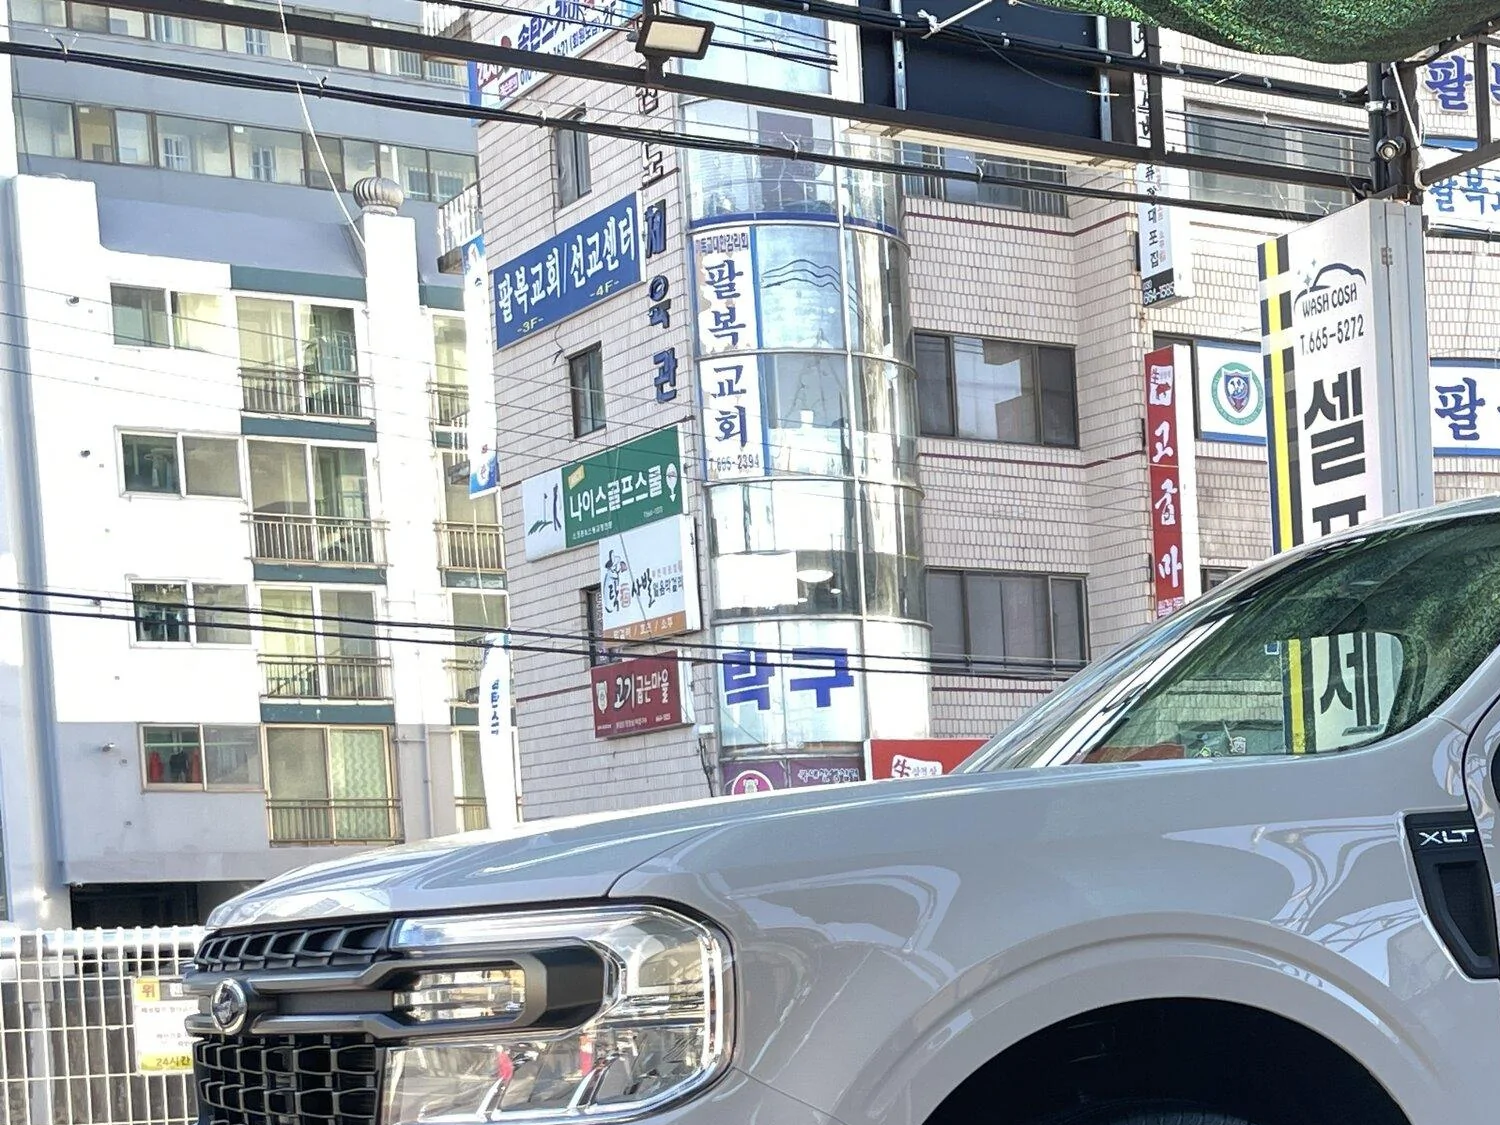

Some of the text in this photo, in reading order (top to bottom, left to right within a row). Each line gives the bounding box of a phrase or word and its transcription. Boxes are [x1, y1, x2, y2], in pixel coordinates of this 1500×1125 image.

[1302, 282, 1357, 318] WASH COSH
[705, 259, 747, 448] 팔복교회
[1300, 314, 1364, 356] T.665-5272
[722, 647, 854, 711] 탁구
[1419, 828, 1475, 846] XLT
[156, 1055, 191, 1068] 24시간
